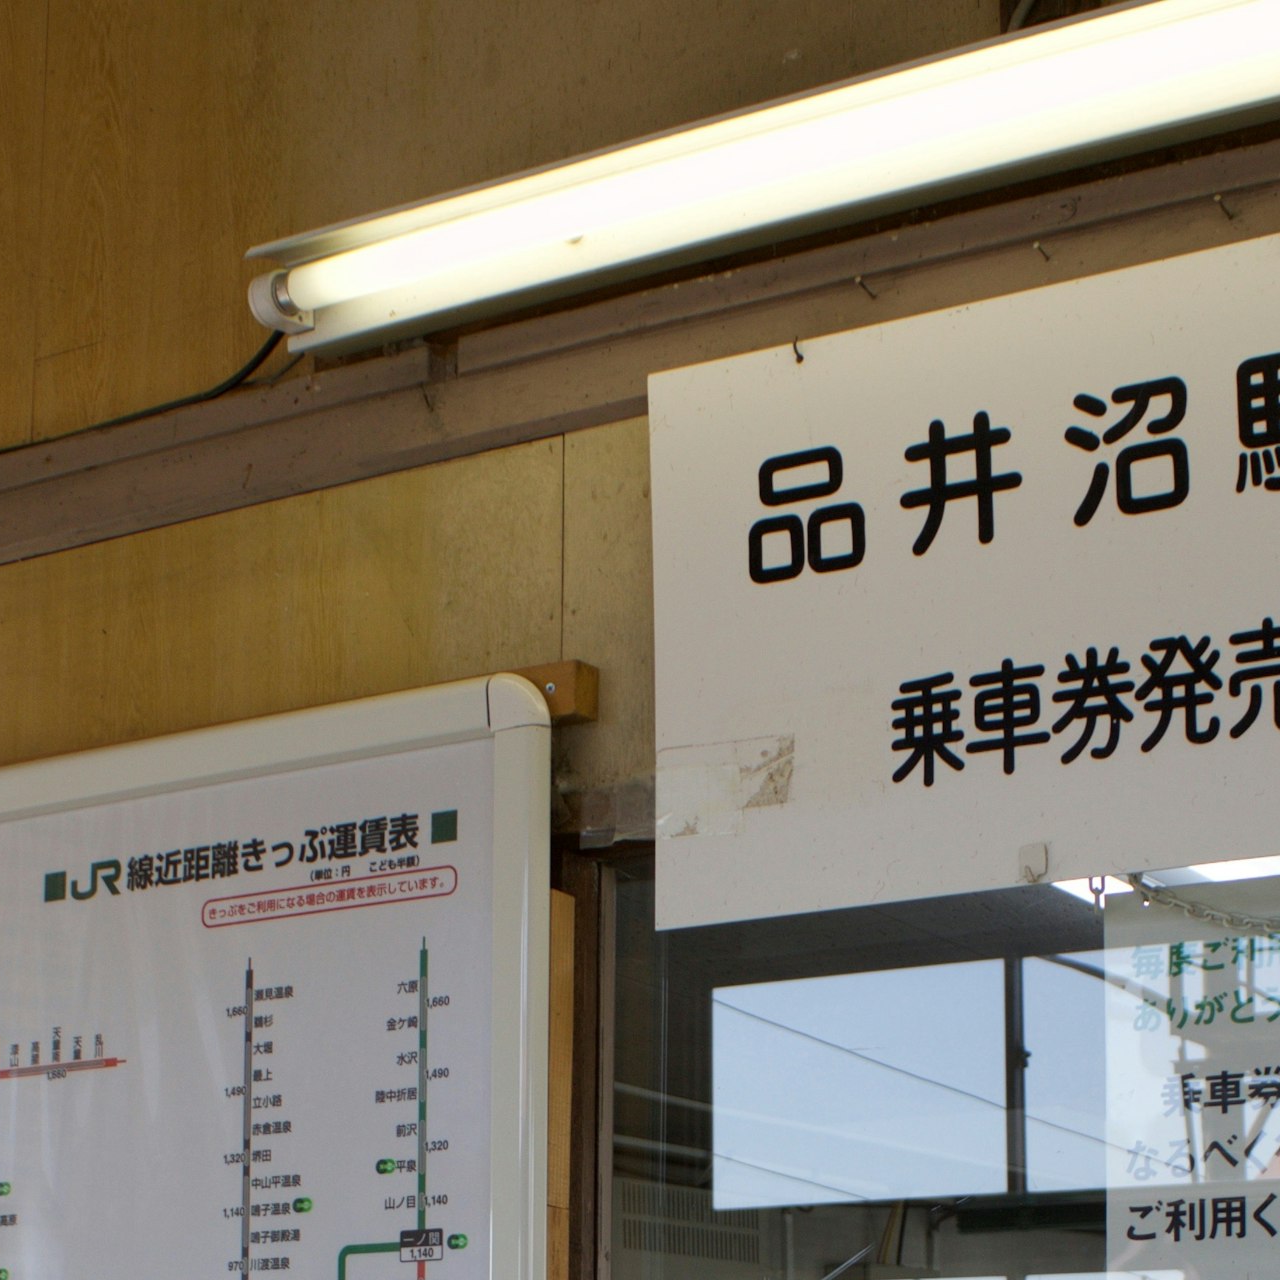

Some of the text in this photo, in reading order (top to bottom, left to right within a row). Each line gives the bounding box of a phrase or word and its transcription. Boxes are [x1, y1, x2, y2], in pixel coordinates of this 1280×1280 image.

[397, 981, 418, 994] 六原
[426, 996, 450, 1008] 1,660
[396, 1052, 418, 1066] 水沢
[426, 1068, 449, 1079] 1,490
[375, 1088, 417, 1103] 陸中折居
[396, 1124, 417, 1137] 前沢
[425, 1140, 448, 1151] 1,320
[396, 1160, 416, 1172] 平泉
[384, 1196, 416, 1210] 山ノ目
[424, 1195, 448, 1206] 1,140
[402, 1232, 440, 1246] 一ノ関
[410, 1248, 434, 1258] 1,140
